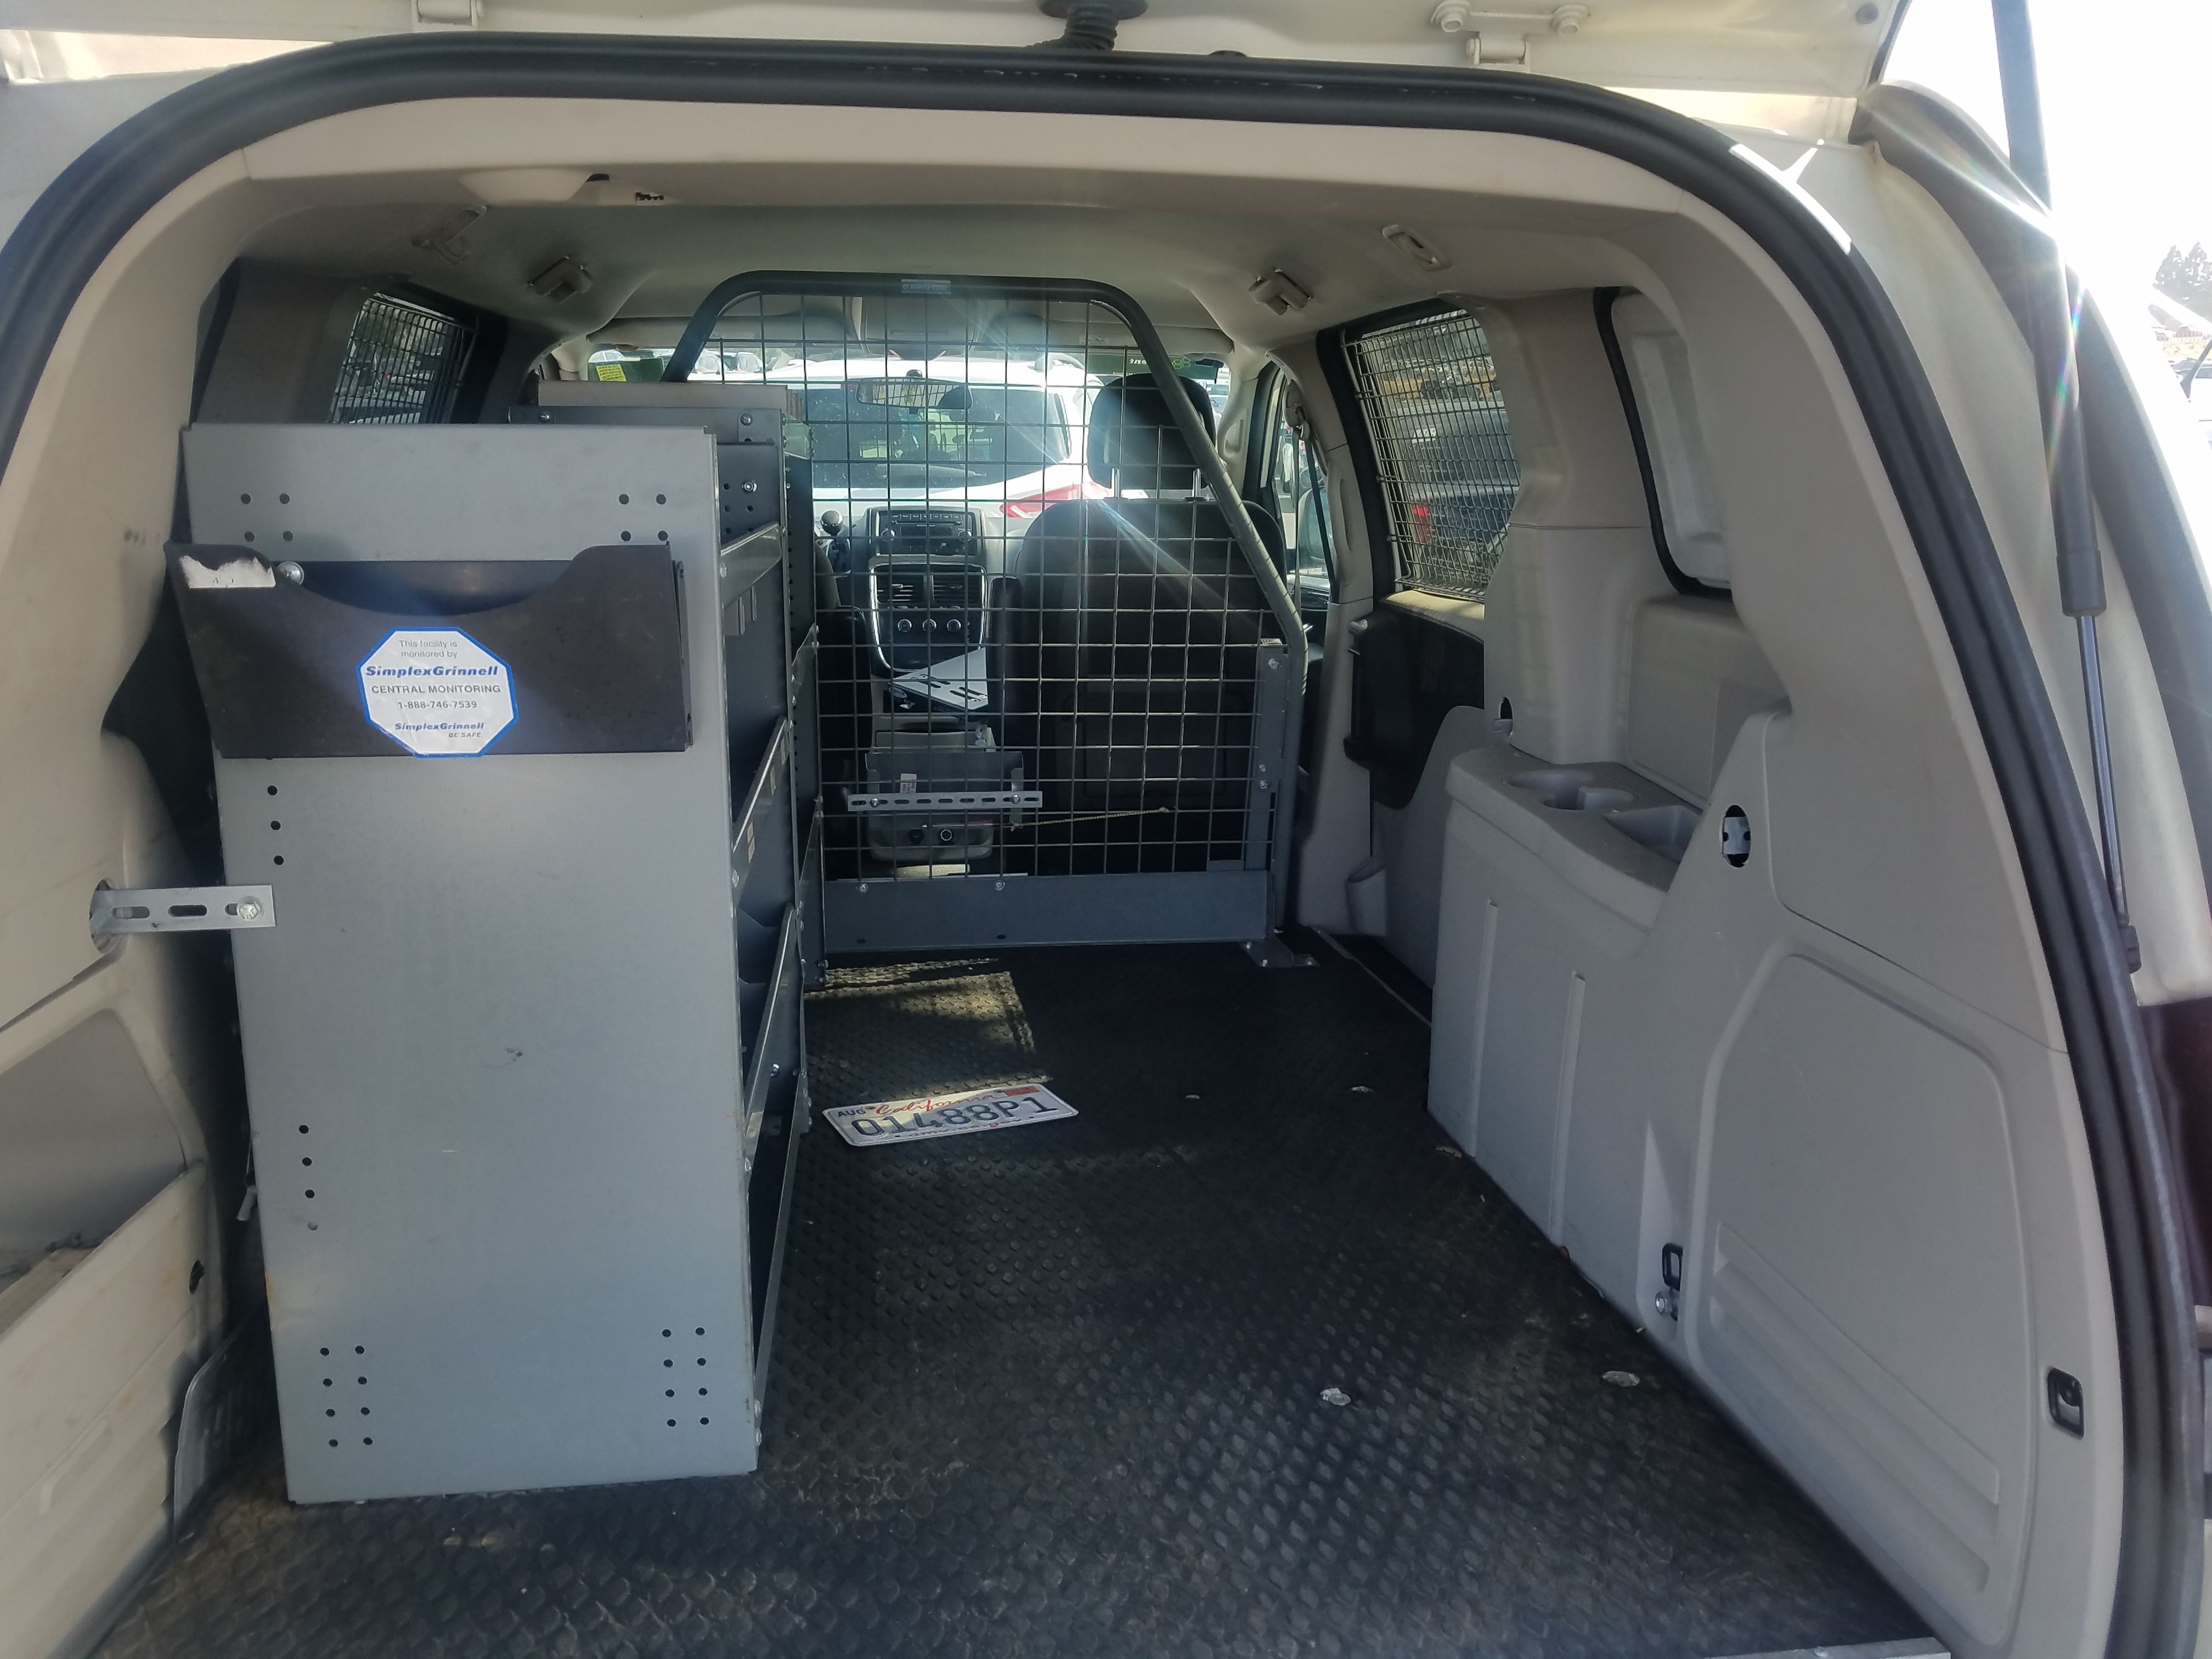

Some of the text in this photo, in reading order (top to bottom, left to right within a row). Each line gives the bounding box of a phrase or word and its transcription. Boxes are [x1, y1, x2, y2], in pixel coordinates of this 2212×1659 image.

[420, 640, 448, 649] facility
[447, 650, 458, 659] by
[365, 665, 499, 678] SimplexGrinnell
[371, 684, 501, 694] CENTRAL MONITORING
[398, 700, 478, 709] 1-888-746-7539
[394, 722, 484, 731] SimplexGrinnell
[837, 1095, 1005, 1117] AUG California
[851, 1097, 1058, 1136] 01488P1
